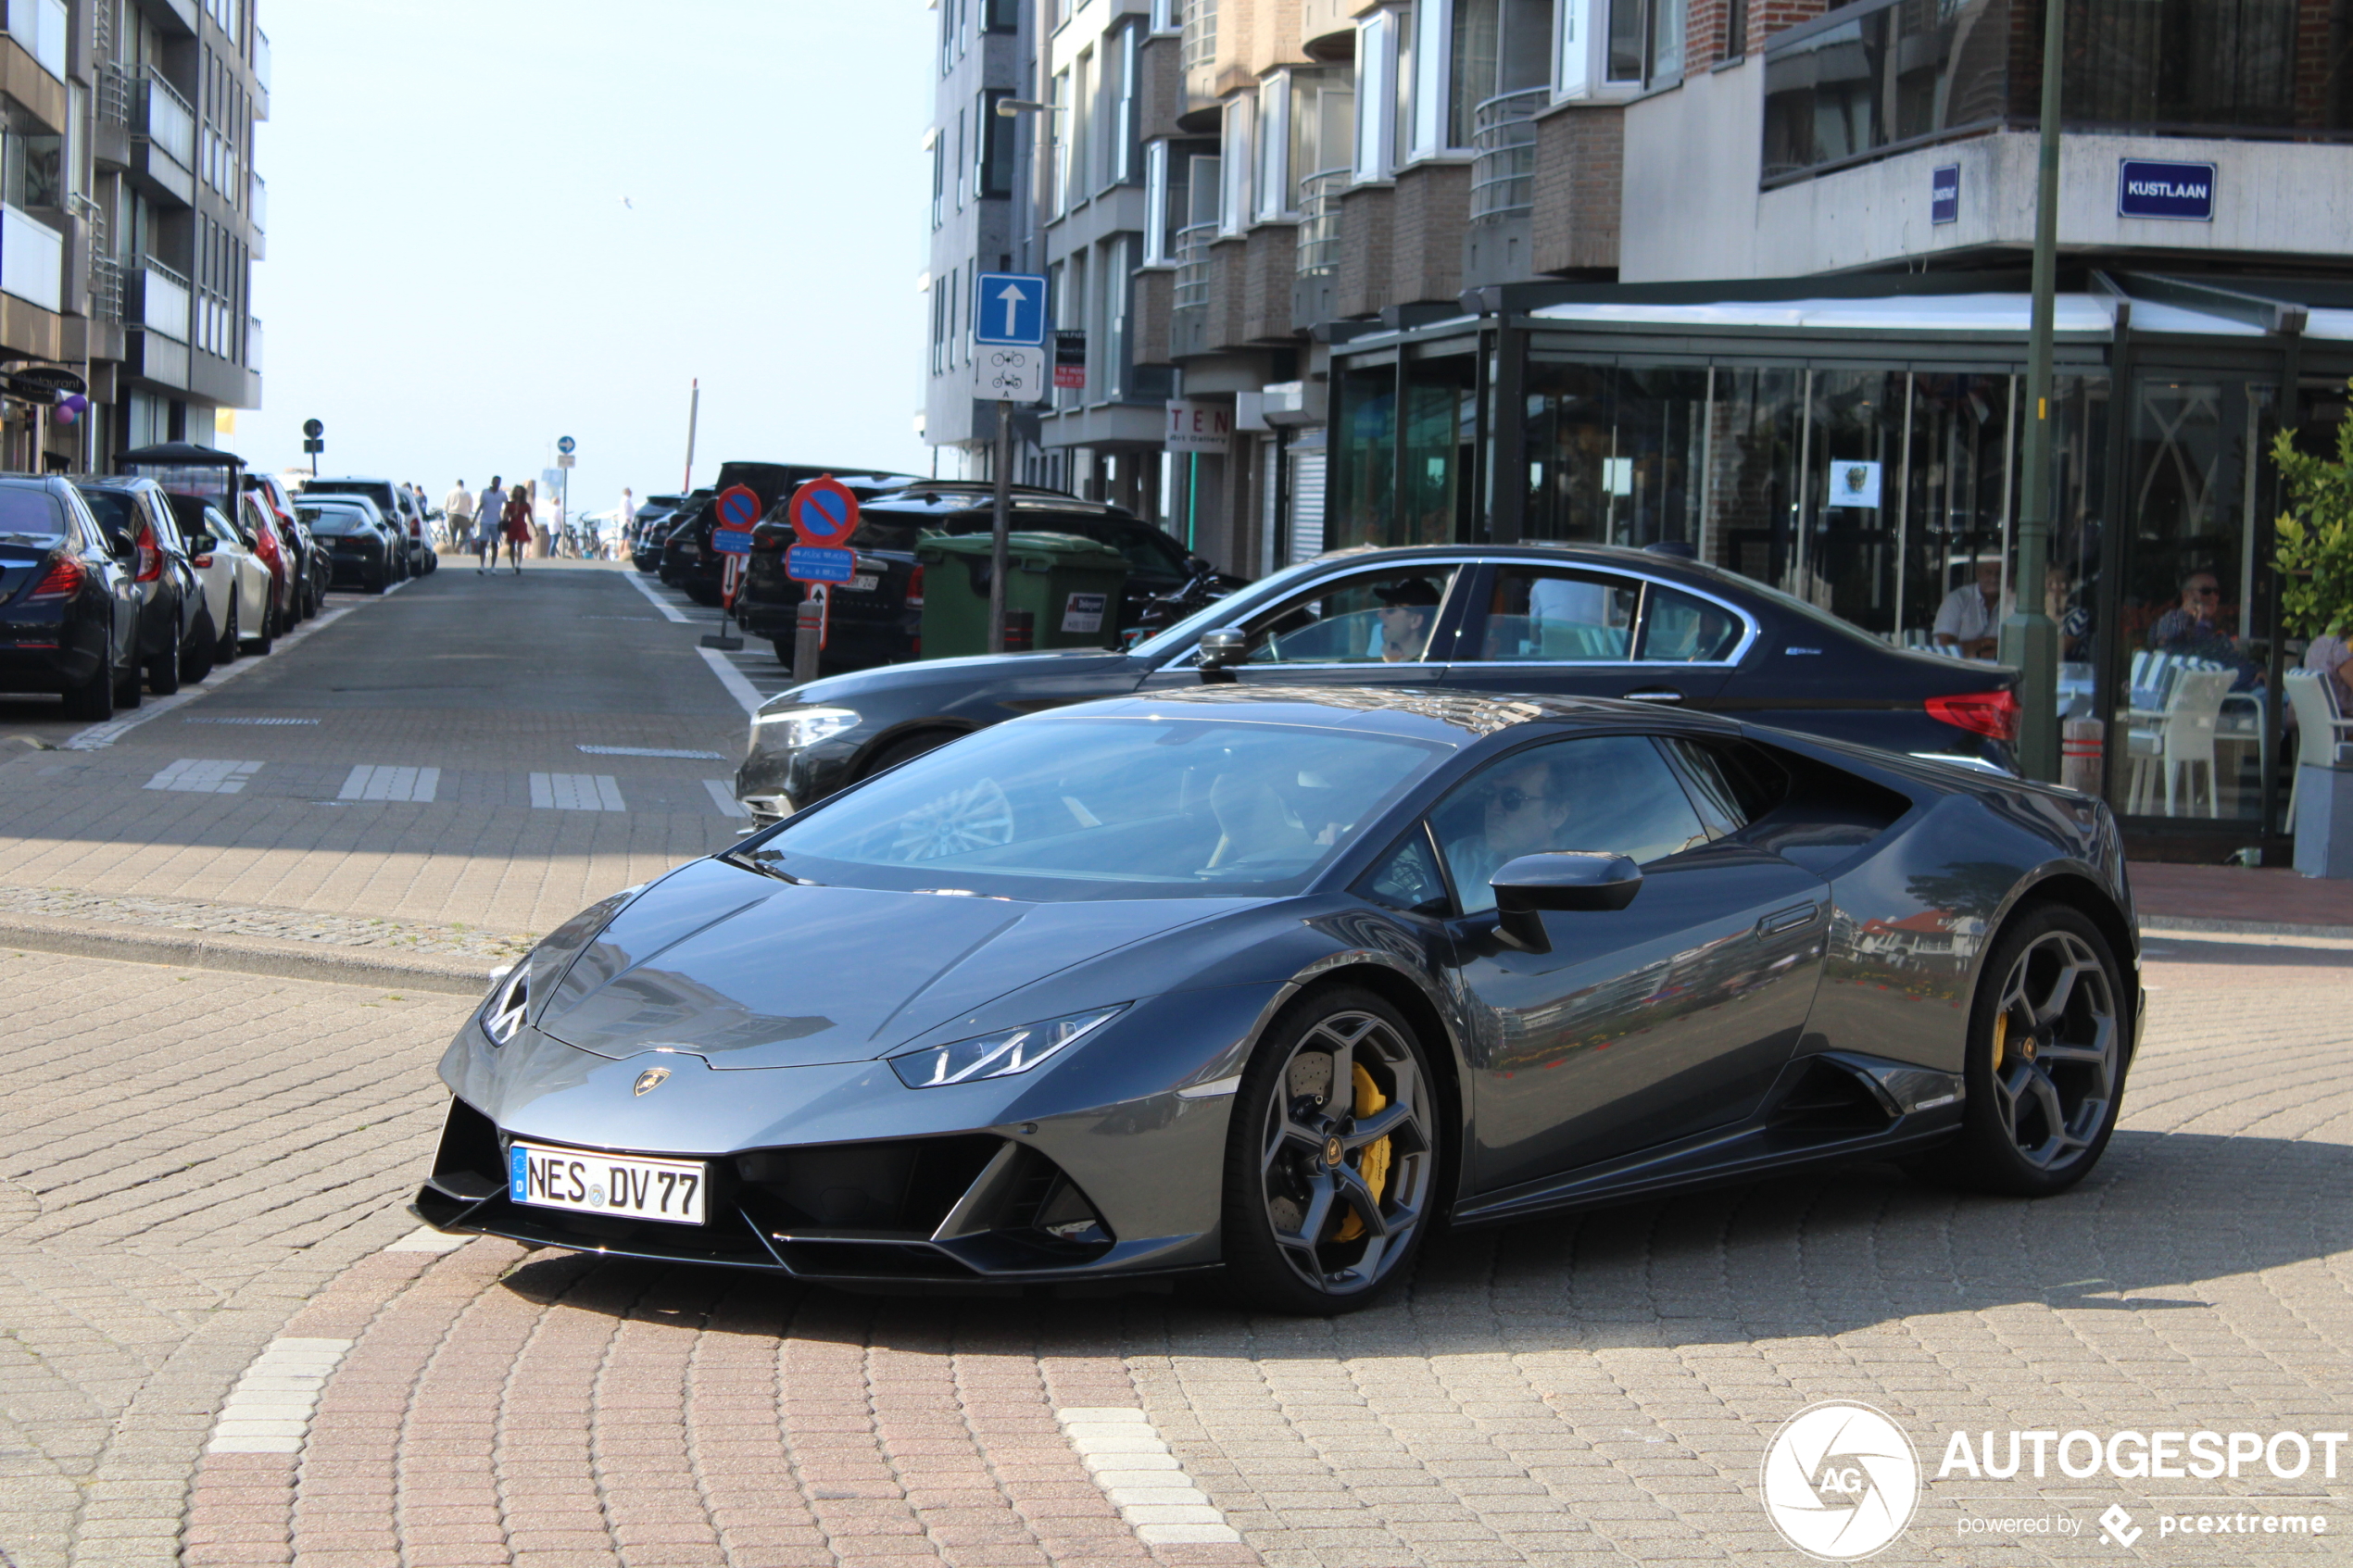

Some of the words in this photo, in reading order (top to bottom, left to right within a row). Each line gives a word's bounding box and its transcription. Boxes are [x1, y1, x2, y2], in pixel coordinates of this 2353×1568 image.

[2128, 181, 2207, 199] KUSTLAAN
[1171, 409, 1228, 433] TEN
[1189, 435, 1227, 444] Gallery
[516, 1180, 523, 1193] D
[528, 1156, 585, 1202] NES
[609, 1166, 650, 1210] DV
[658, 1171, 698, 1215] 77
